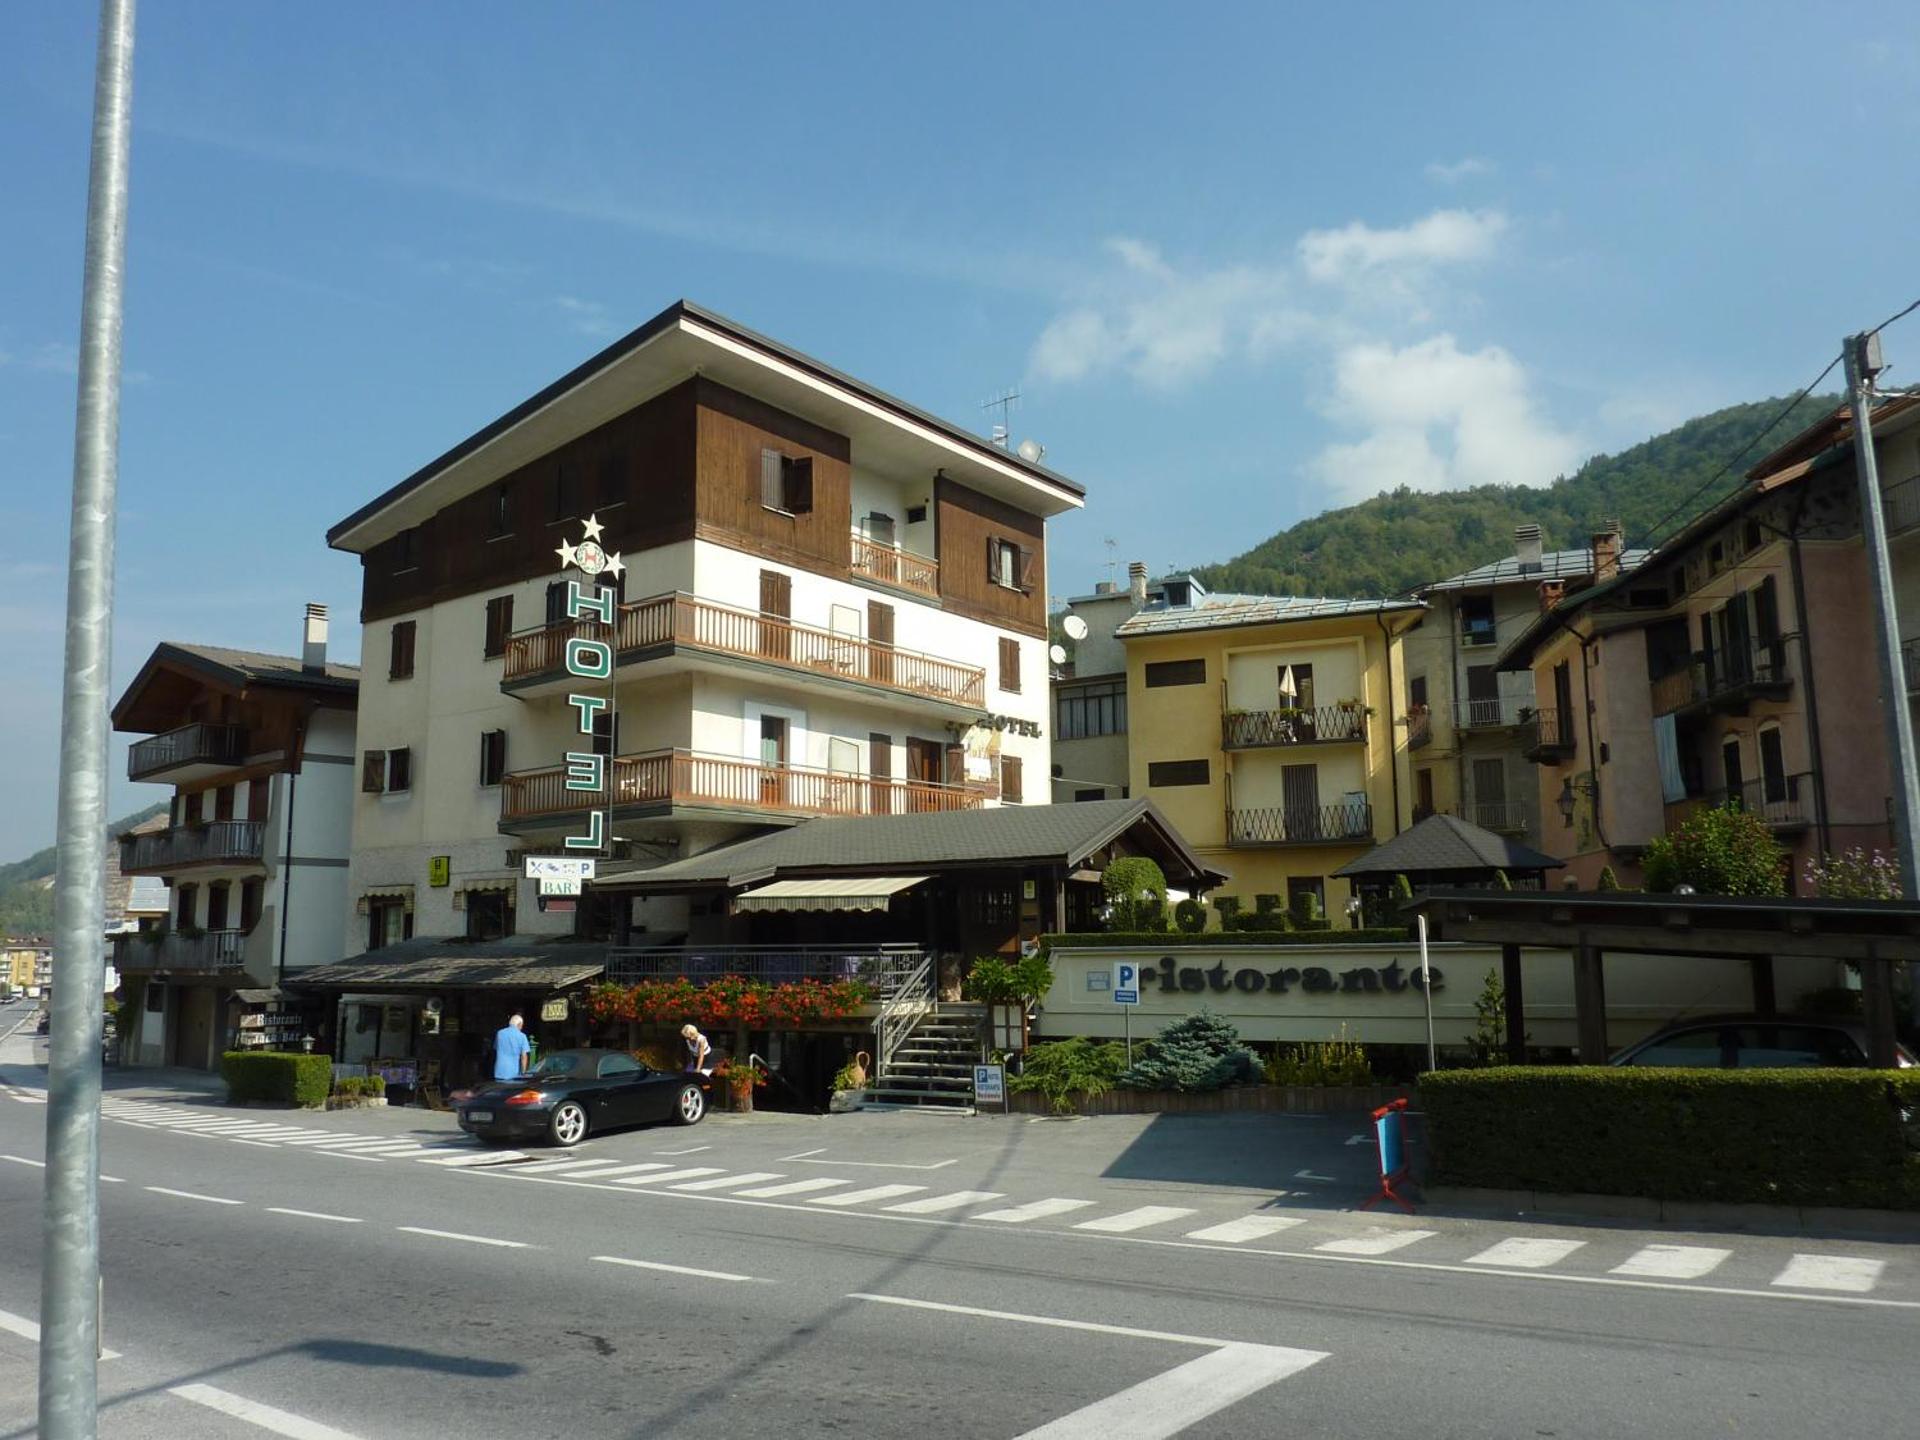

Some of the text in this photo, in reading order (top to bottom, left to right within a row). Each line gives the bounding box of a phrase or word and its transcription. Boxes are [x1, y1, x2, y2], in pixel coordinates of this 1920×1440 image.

[581, 863, 590, 874] P
[544, 882, 572, 894] BAR
[1120, 966, 1133, 987] P
[1138, 957, 1445, 993] ristorante
[979, 1070, 987, 1081] P
